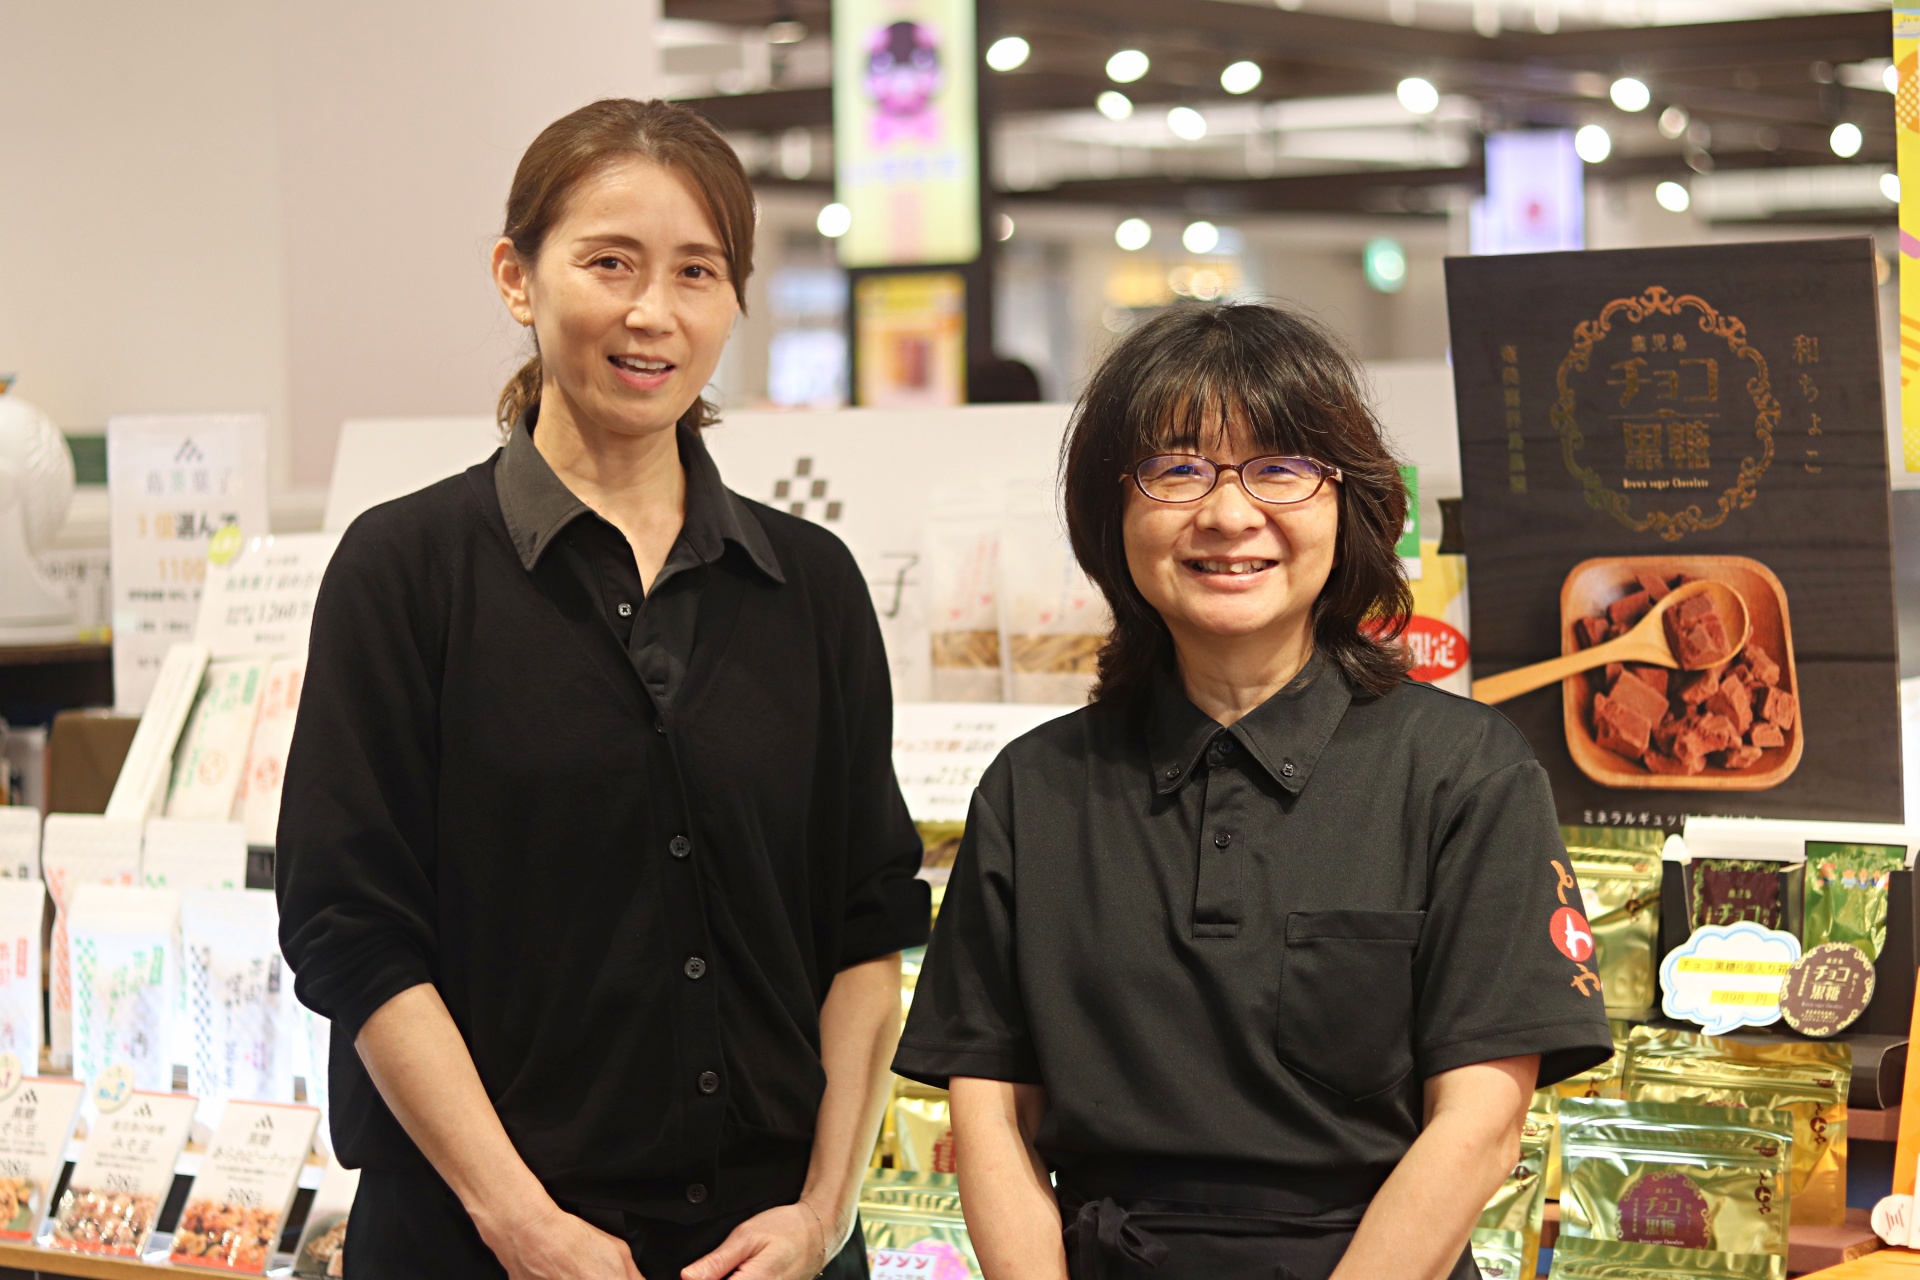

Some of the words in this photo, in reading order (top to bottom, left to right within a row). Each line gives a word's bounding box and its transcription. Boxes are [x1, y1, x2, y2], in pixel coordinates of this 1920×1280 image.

[1606, 357, 1718, 408] チョコ
[1793, 335, 1823, 474] 和ちょこ
[1622, 421, 1710, 470] 黒糖
[873, 553, 920, 619] 子
[1813, 965, 1850, 983] チョコ
[1644, 1197, 1682, 1215] チョコ
